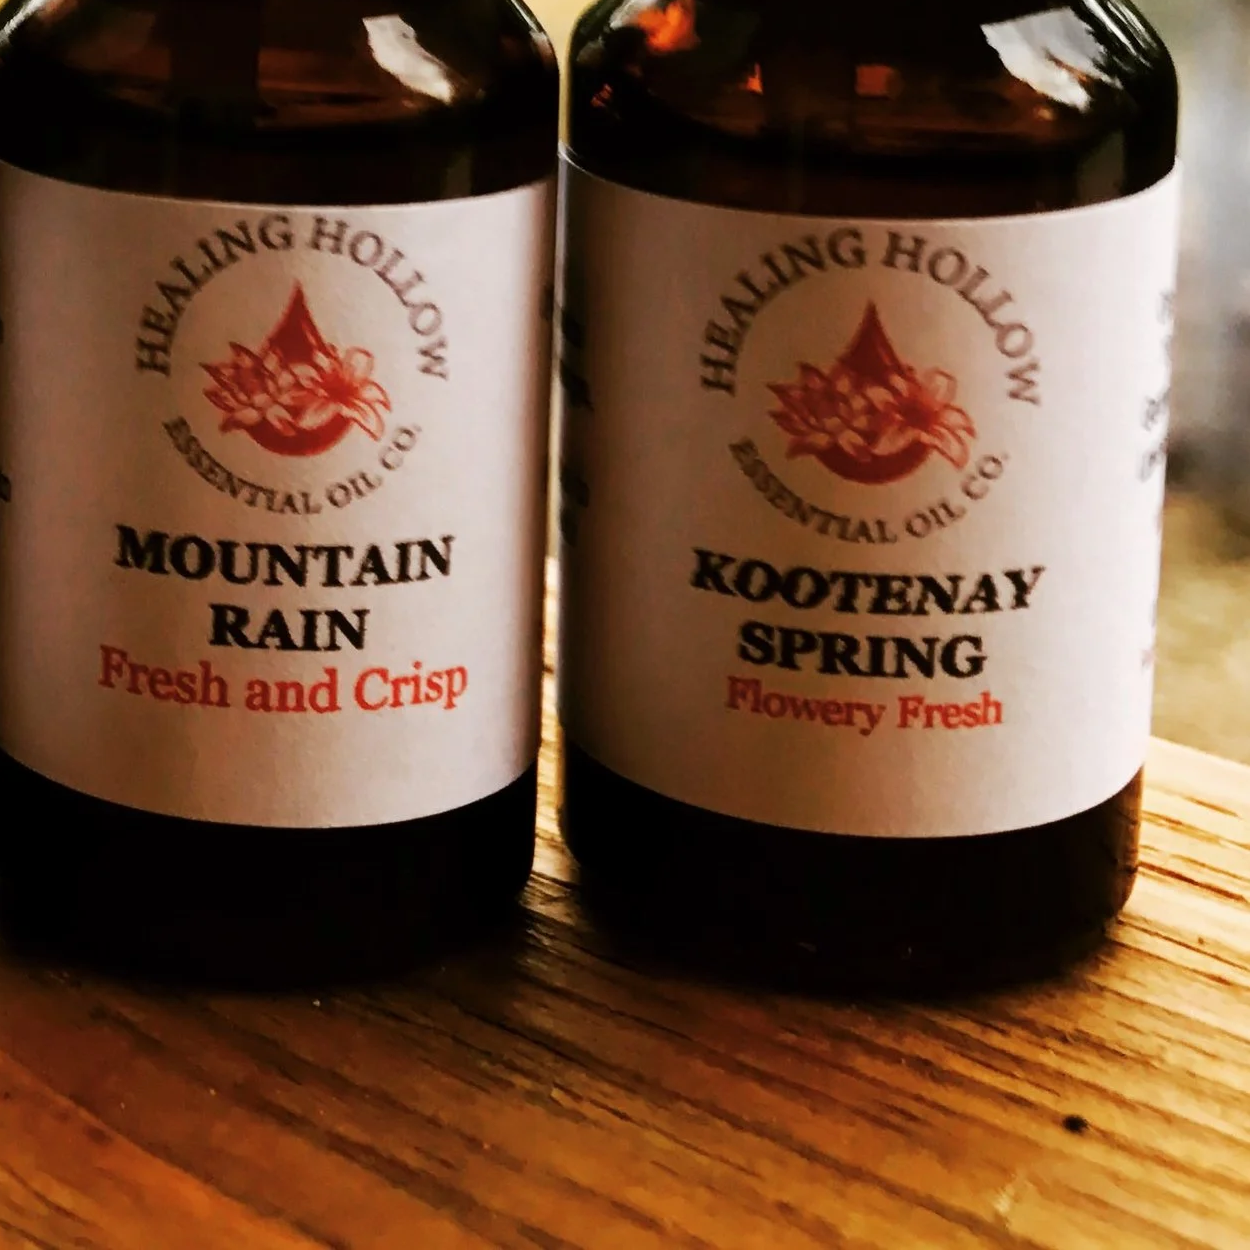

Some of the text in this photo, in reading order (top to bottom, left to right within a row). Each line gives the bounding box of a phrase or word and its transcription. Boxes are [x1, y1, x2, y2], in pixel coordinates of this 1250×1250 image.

[136, 213, 447, 380] HEALING HOLLOW
[699, 228, 1042, 406] HEALING HOLLOW
[162, 416, 321, 515] ESSENTIAL
[325, 470, 382, 511] OIL
[729, 438, 897, 544] ESSENTIAL
[904, 502, 964, 540] OIL
[114, 525, 455, 587] MOUNTAIN
[691, 549, 1045, 616] KOOTENAY
[209, 603, 369, 651] RAIN
[737, 622, 987, 679] SPRING
[98, 645, 467, 713] Fresh and Crisp
[725, 677, 1003, 735] Flowery Fresh
